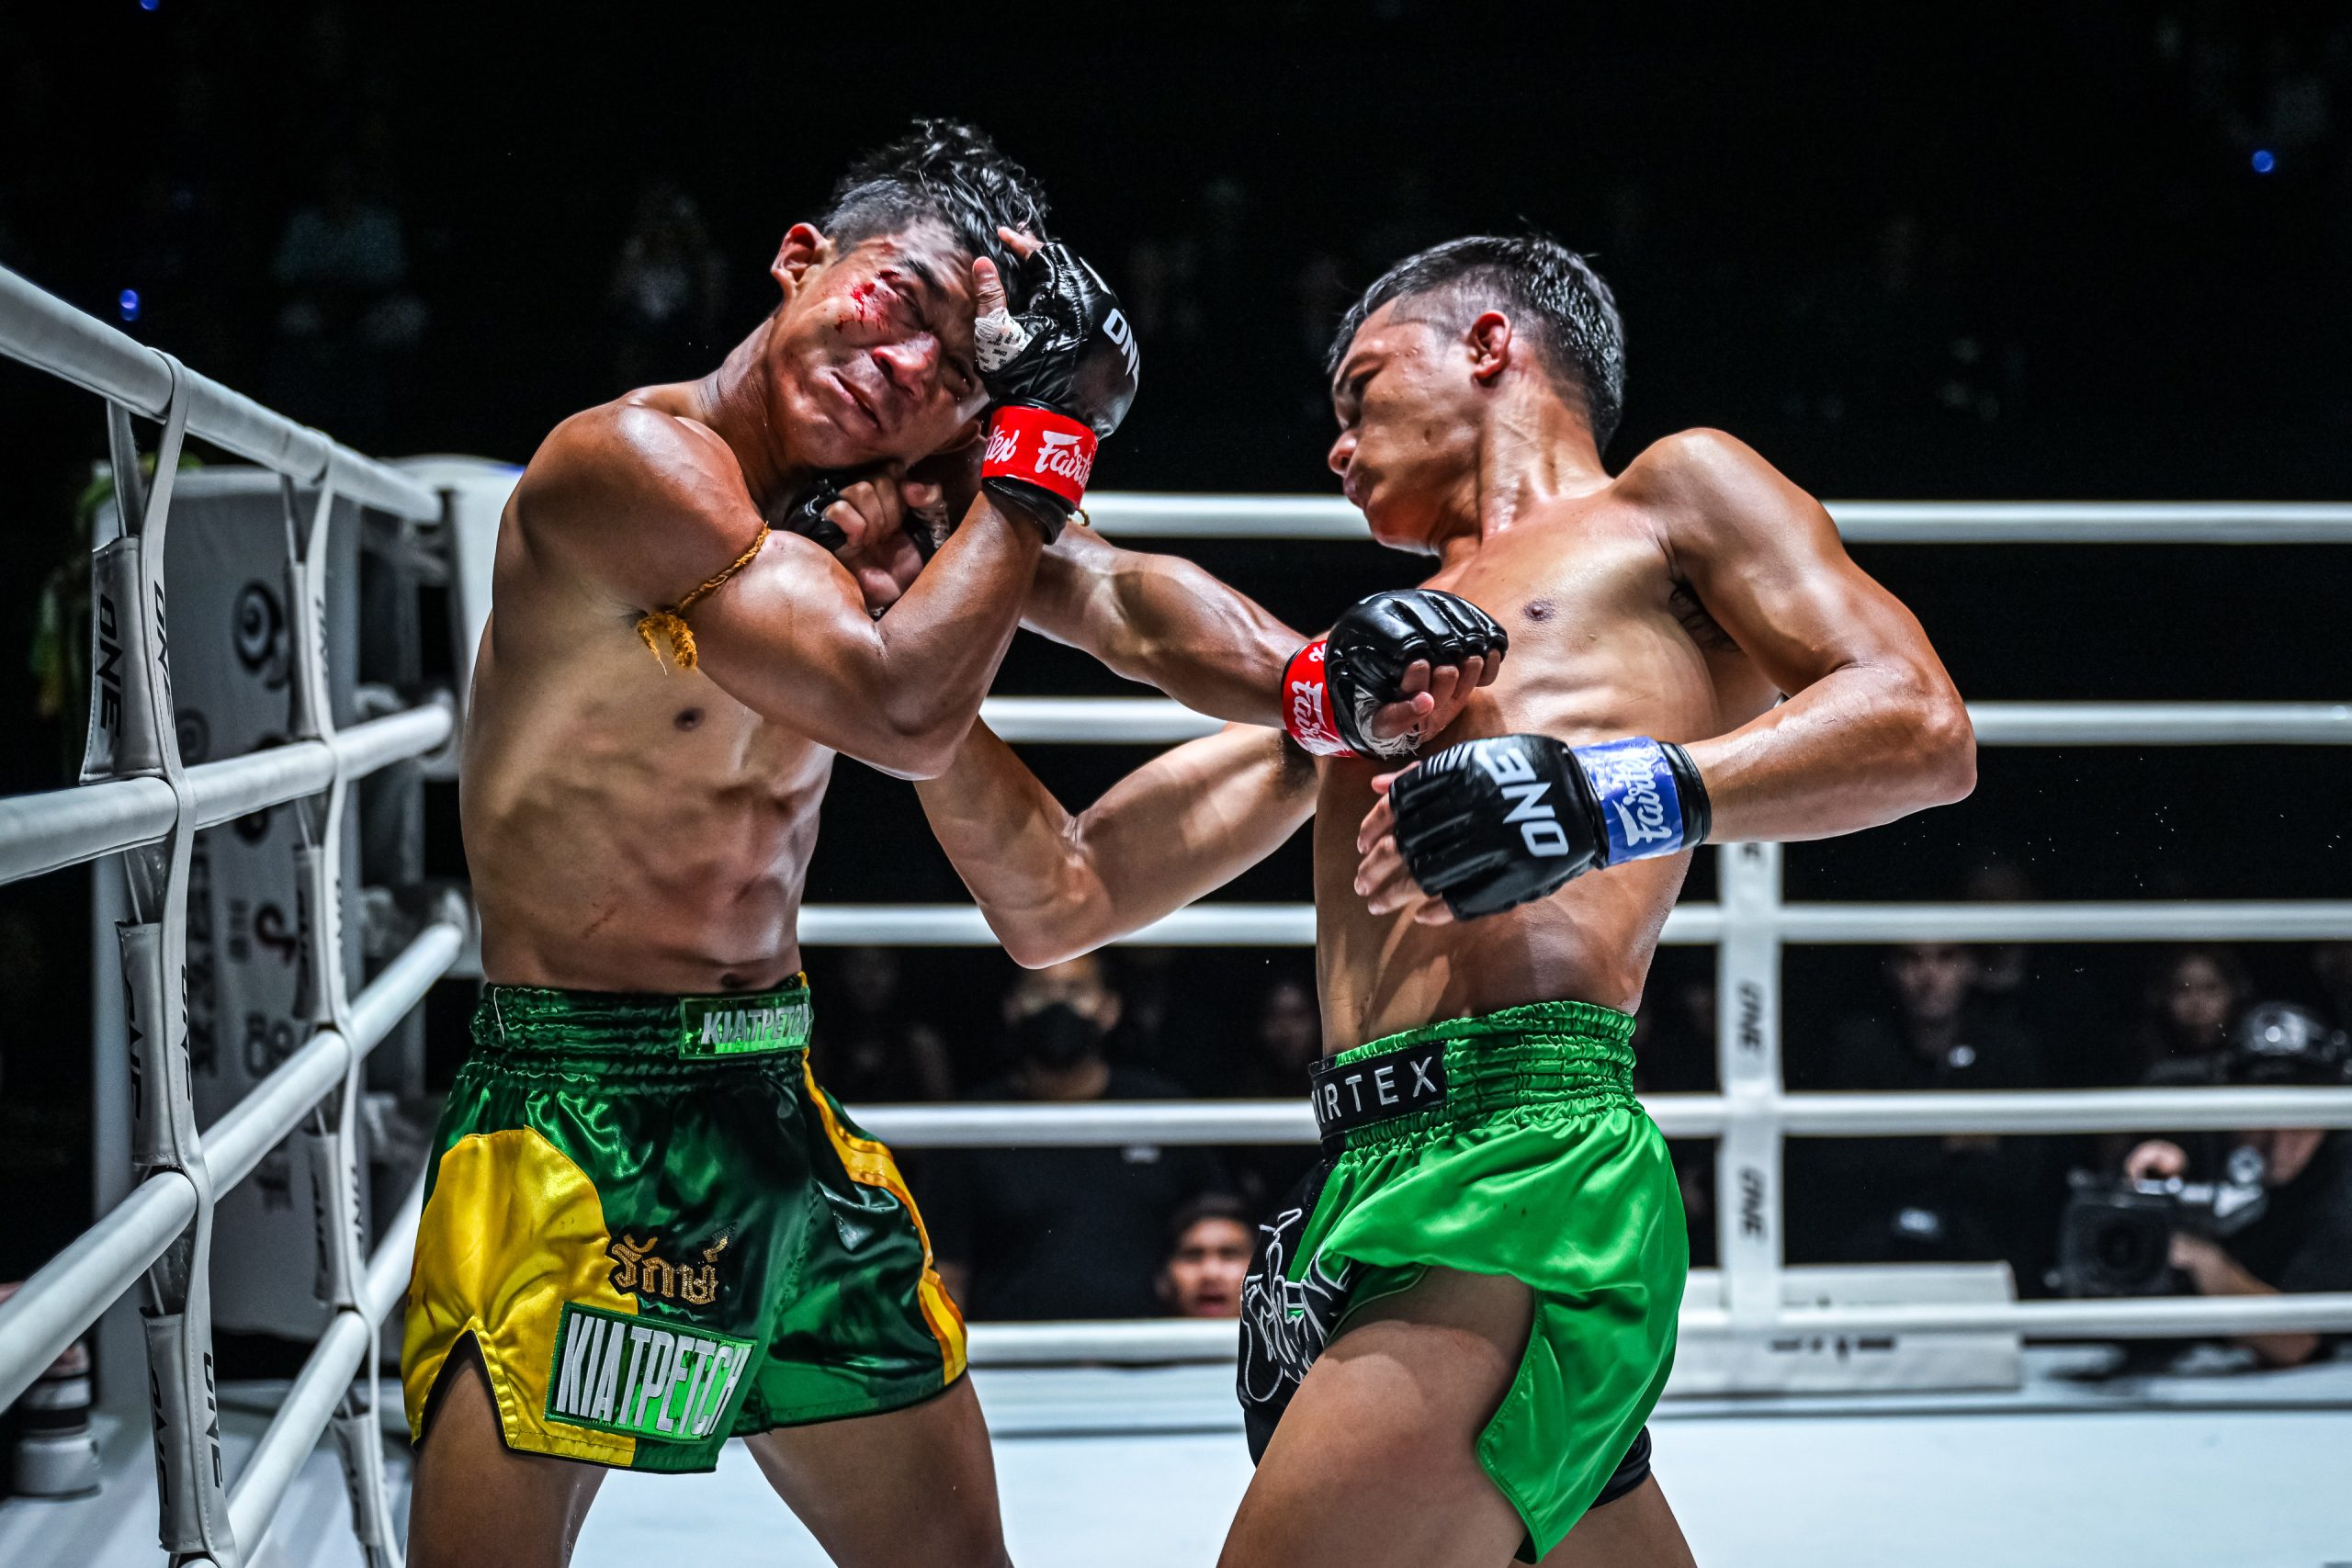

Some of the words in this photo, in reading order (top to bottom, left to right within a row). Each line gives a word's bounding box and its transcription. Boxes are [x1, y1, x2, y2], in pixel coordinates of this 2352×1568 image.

[99, 593, 123, 738] ONE
[1473, 736, 1569, 858] ONE
[612, 1234, 729, 1304] รักษ์
[556, 1313, 752, 1436] KIATPETCH
